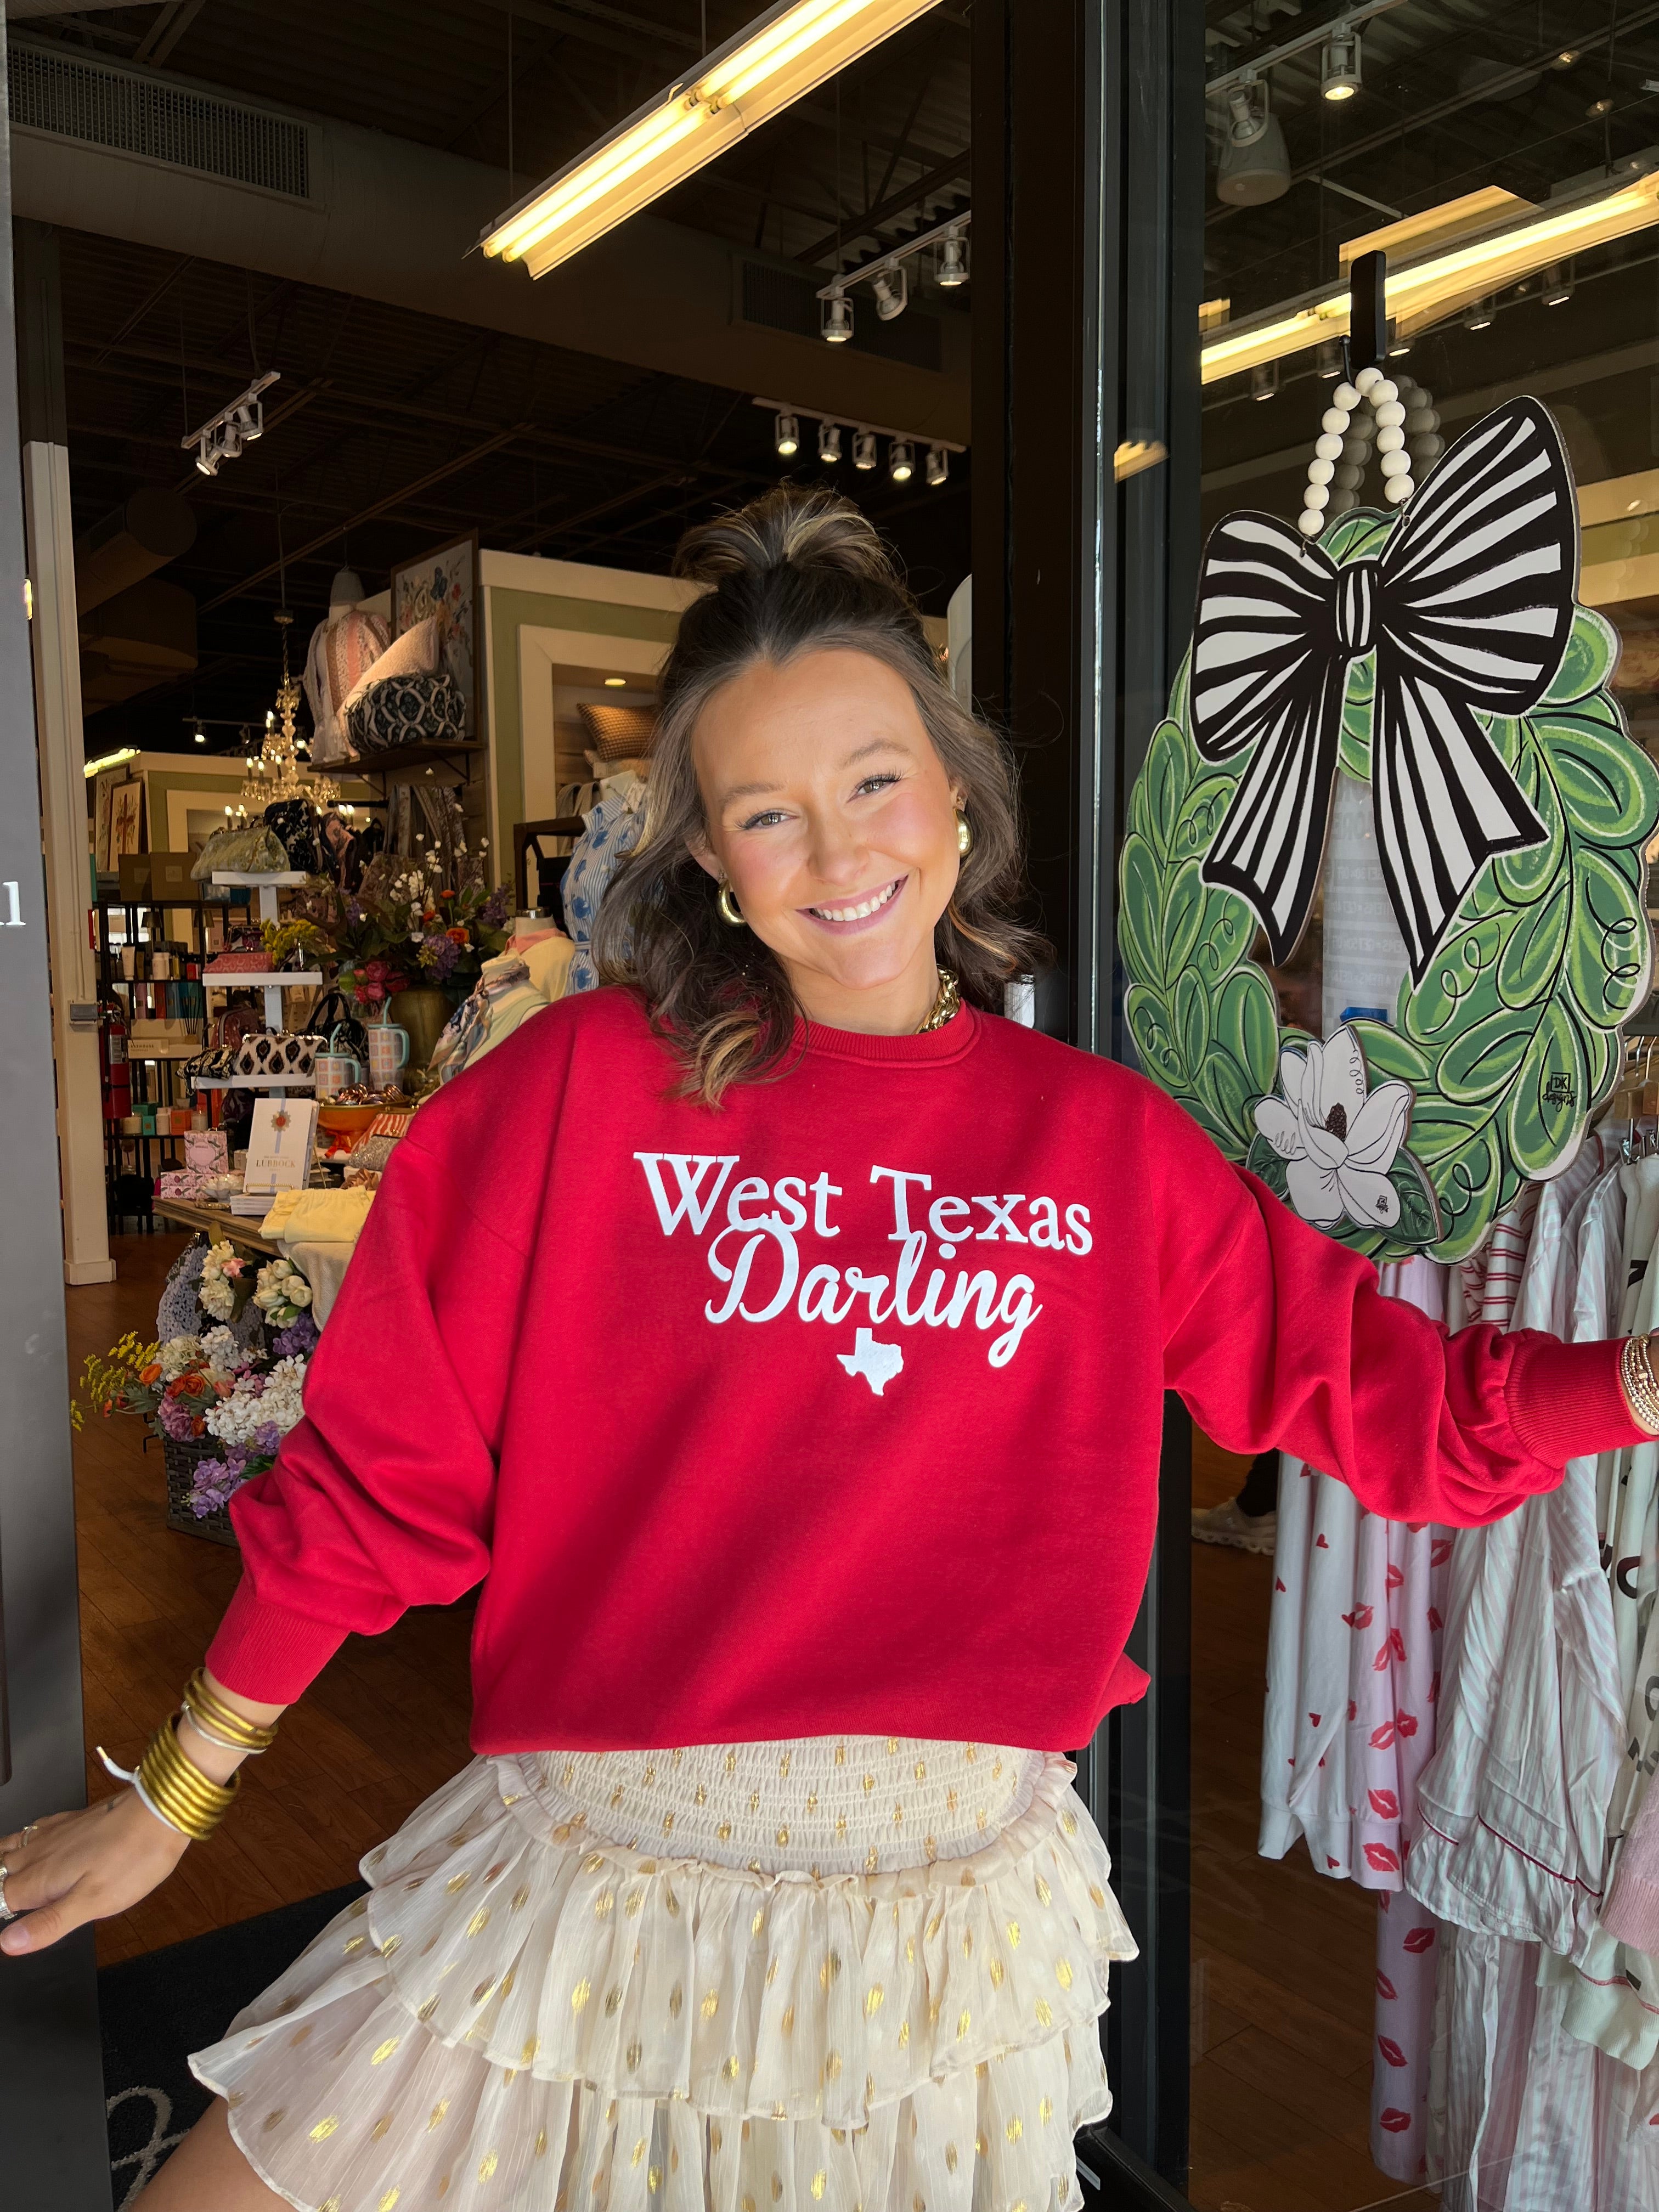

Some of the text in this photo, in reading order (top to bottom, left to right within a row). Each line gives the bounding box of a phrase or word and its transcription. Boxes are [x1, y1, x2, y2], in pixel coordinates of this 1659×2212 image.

[256, 1159, 296, 1168] LUBBOCK
[634, 1152, 1092, 1255] West Texas
[704, 1227, 1043, 1368] Darling
